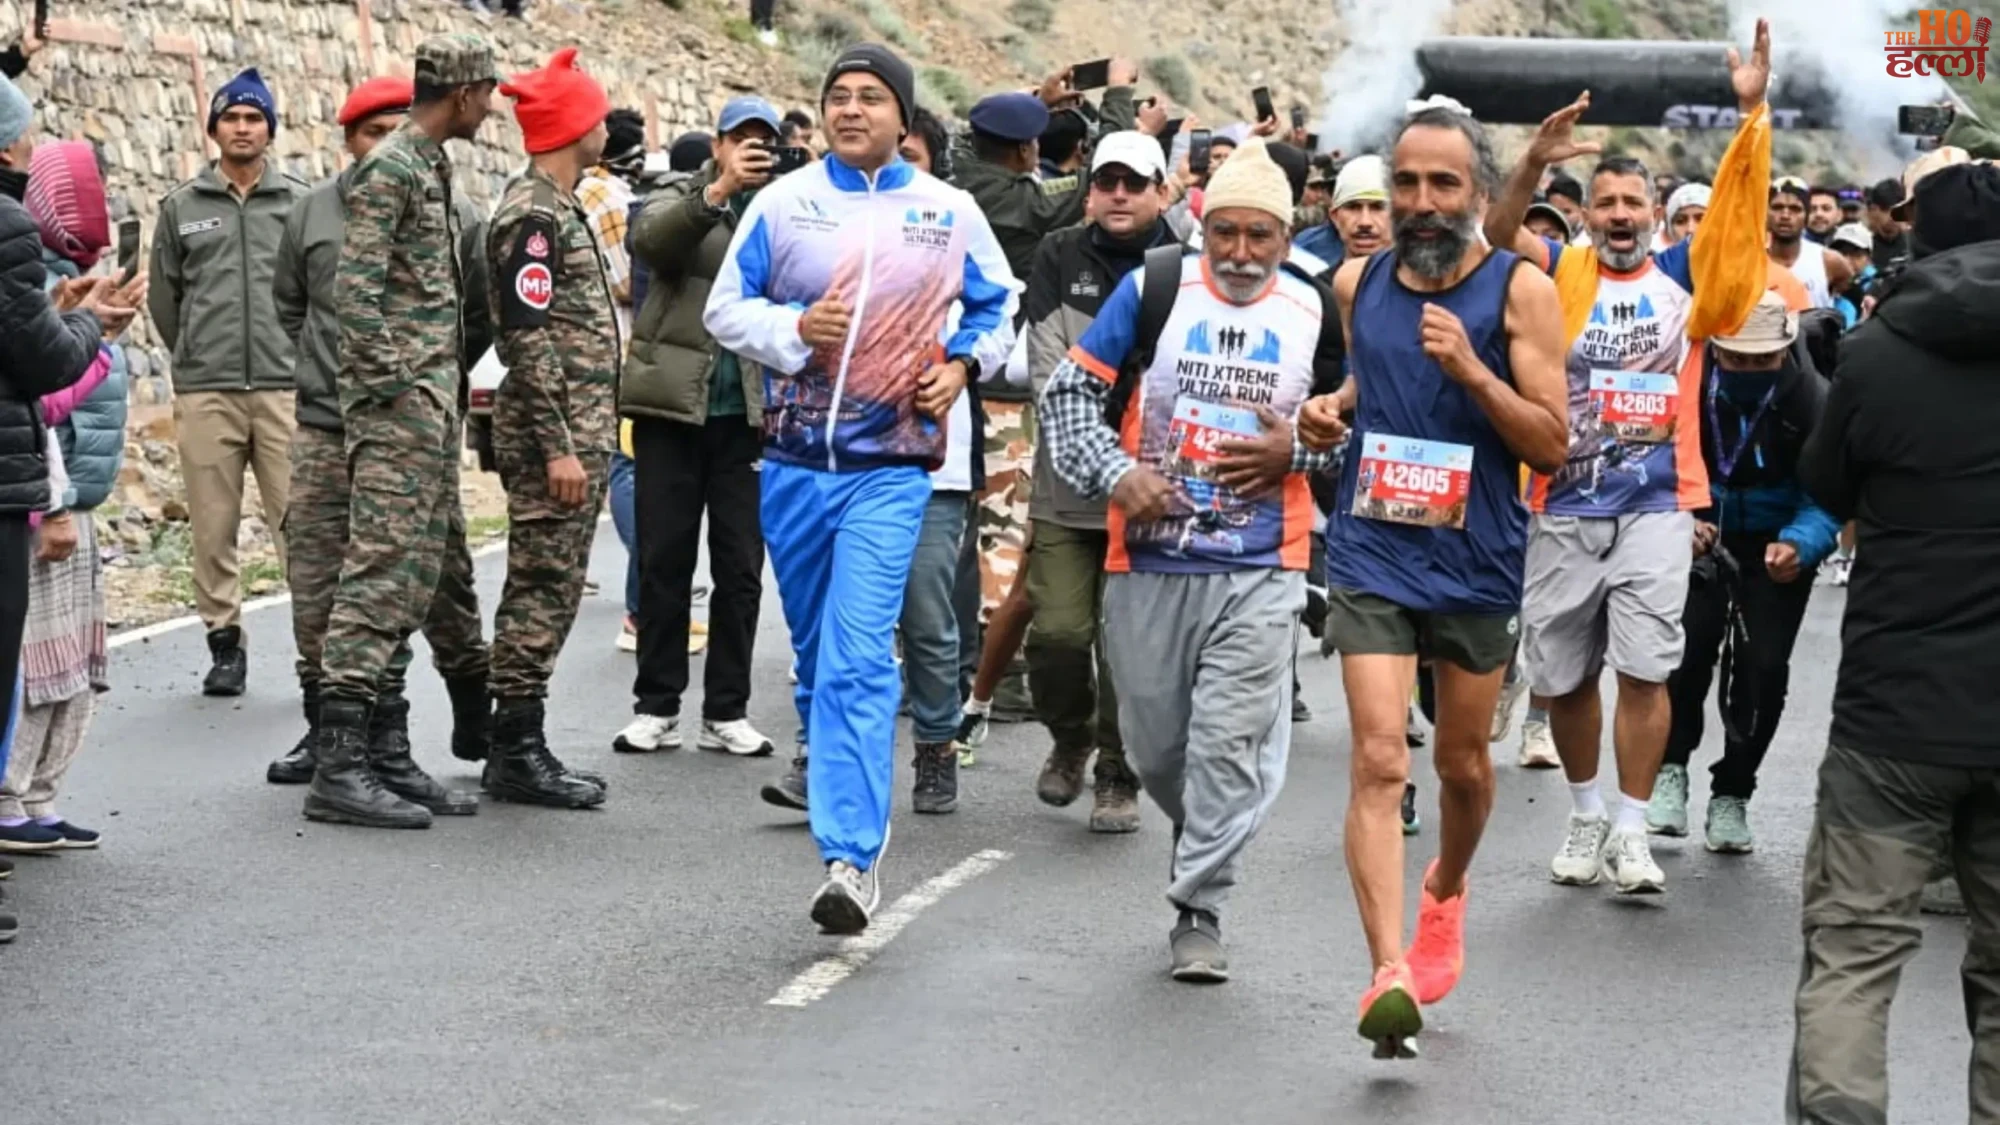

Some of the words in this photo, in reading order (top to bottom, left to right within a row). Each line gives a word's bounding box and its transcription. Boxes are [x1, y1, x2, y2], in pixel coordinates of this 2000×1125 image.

[1661, 104, 1802, 130] STAT
[1630, 337, 1659, 356] RUN
[1176, 358, 1209, 379] NITI
[1212, 364, 1280, 389] XTREME
[1179, 376, 1231, 400] ULTRA
[1236, 385, 1273, 405] RUN
[1611, 393, 1668, 416] 42603
[1381, 461, 1452, 496] 42605
